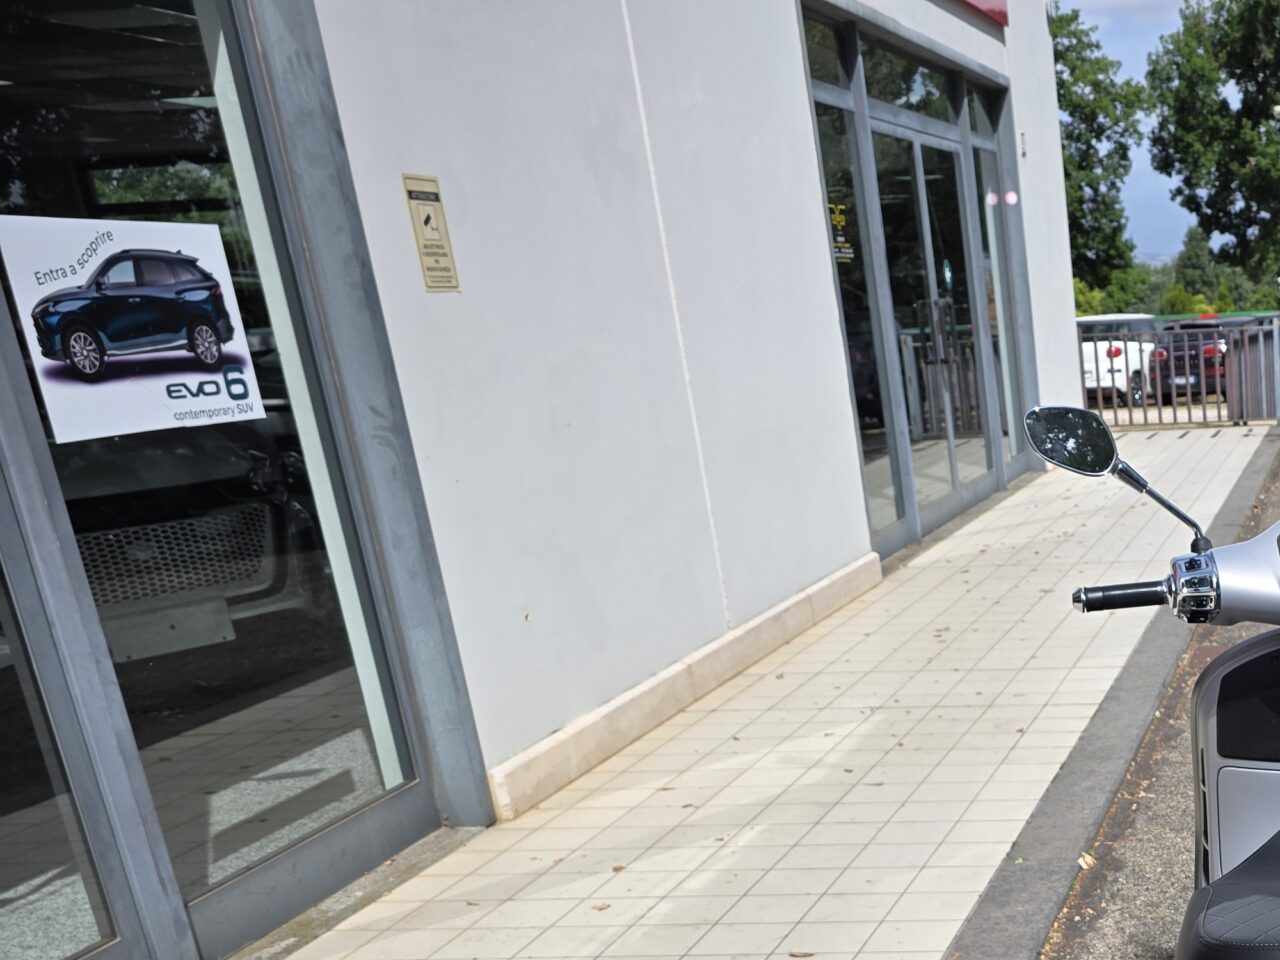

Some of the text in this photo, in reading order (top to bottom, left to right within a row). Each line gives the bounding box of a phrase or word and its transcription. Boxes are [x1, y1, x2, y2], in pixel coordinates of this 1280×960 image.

[34, 230, 114, 286] Entra a scoprire
[166, 364, 249, 401] EVO 6
[174, 402, 254, 421] contemporary SUV
